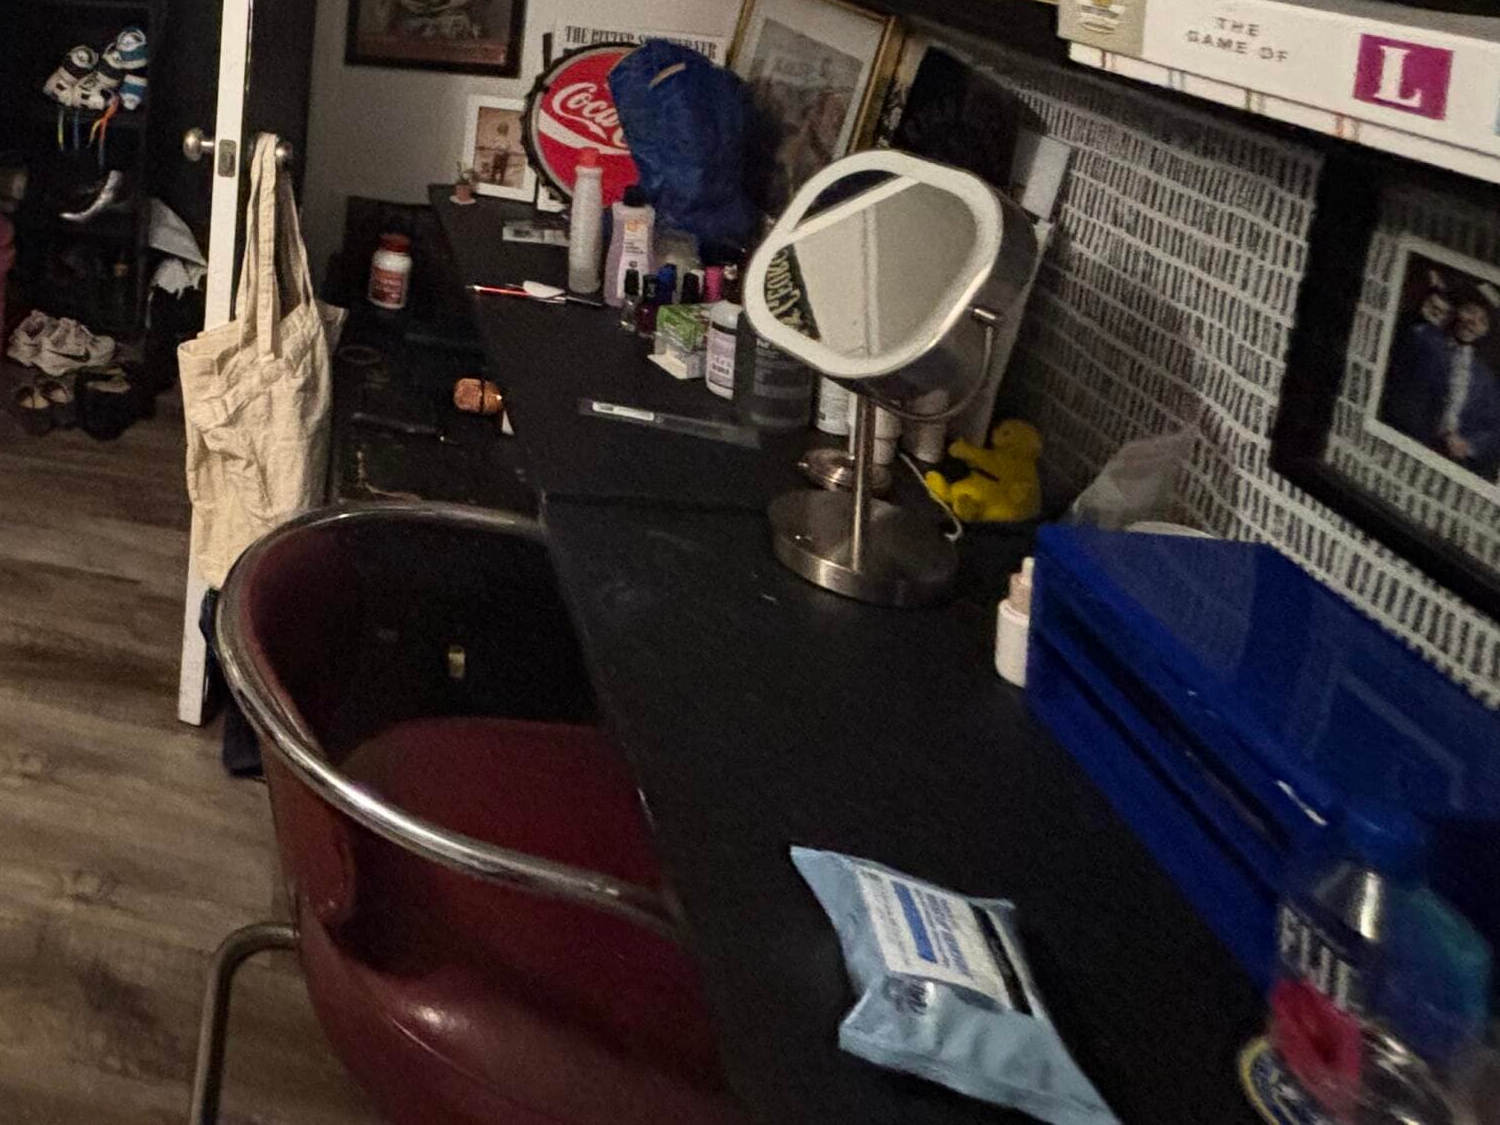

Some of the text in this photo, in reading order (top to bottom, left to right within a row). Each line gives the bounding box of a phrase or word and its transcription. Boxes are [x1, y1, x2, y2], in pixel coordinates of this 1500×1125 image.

[565, 26, 588, 44] THE
[1213, 16, 1261, 38] THE
[1184, 30, 1289, 64] GAME OF
